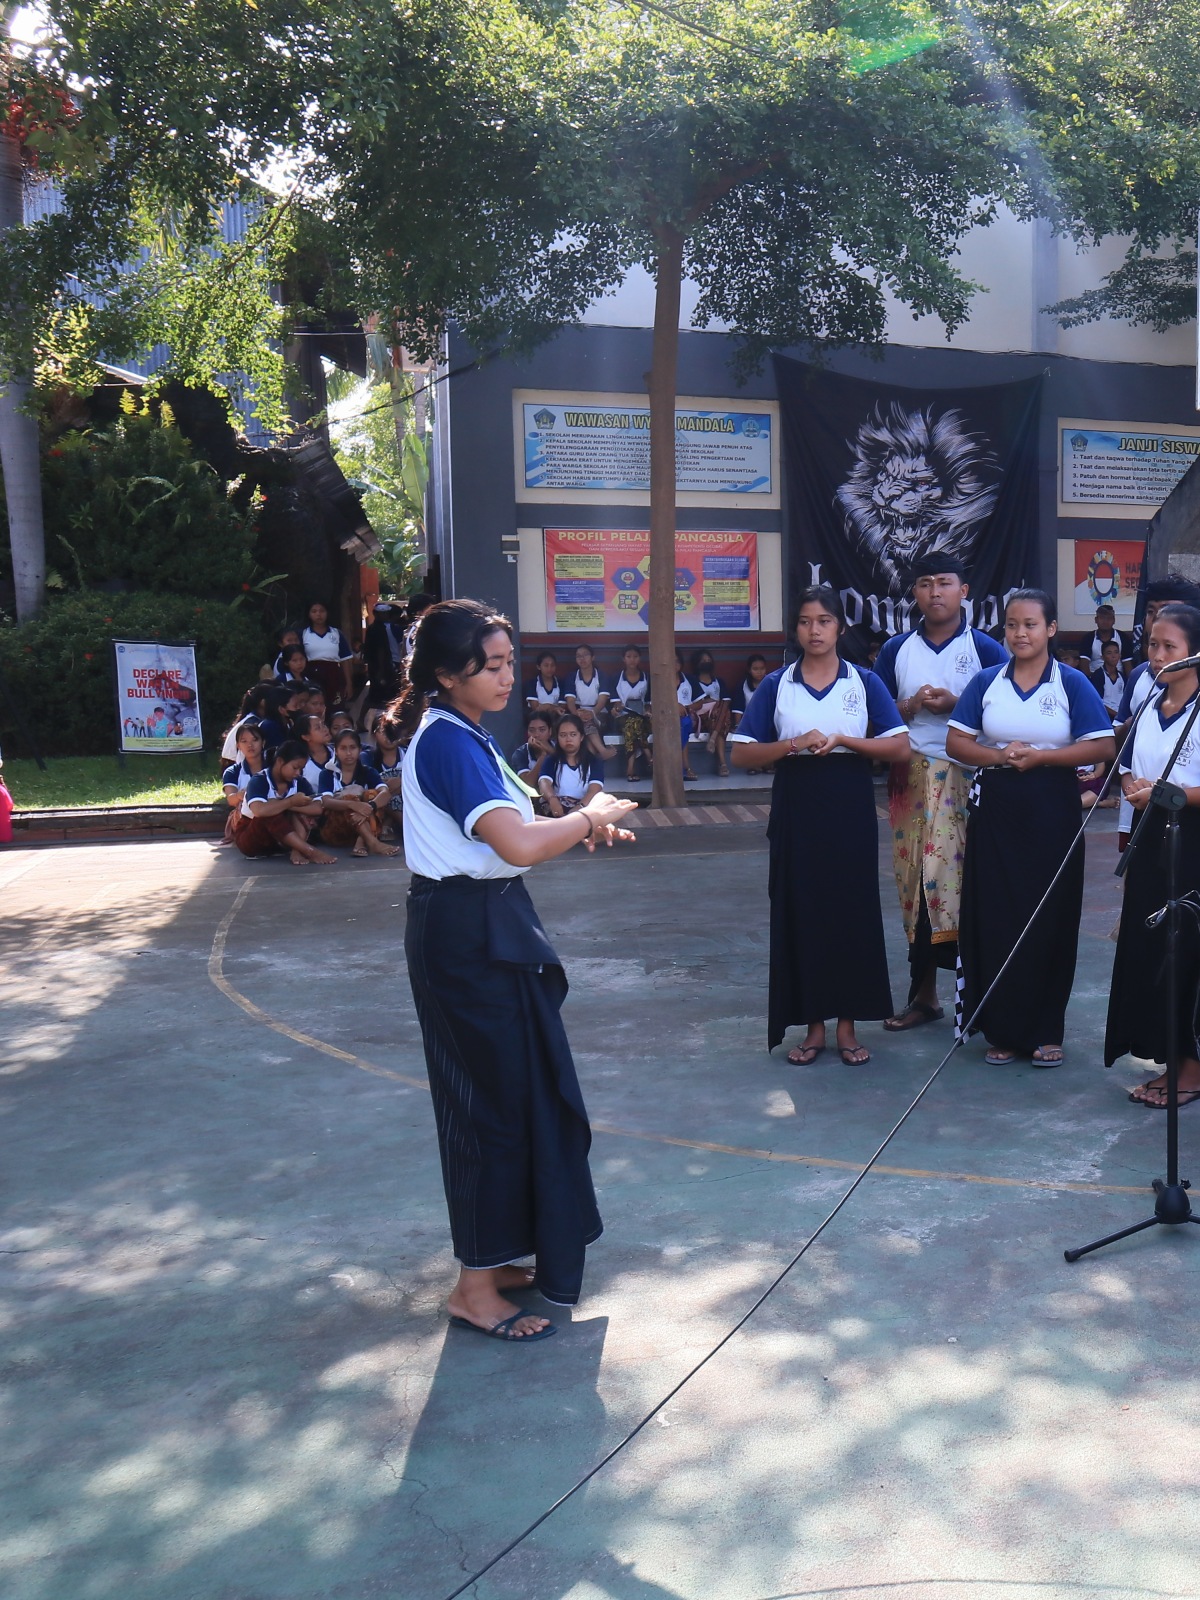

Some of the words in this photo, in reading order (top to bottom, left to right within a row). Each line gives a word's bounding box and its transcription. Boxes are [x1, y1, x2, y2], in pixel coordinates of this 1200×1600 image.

[564, 412, 630, 429] WAWASAN
[676, 416, 735, 433] MANDALA
[1117, 438, 1158, 452] JANJI
[558, 532, 607, 541] PROFIL
[610, 532, 651, 542] PELAJ
[674, 533, 744, 543] PANCASILA
[133, 668, 182, 680] DECLARE
[136, 679, 163, 689] WAR
